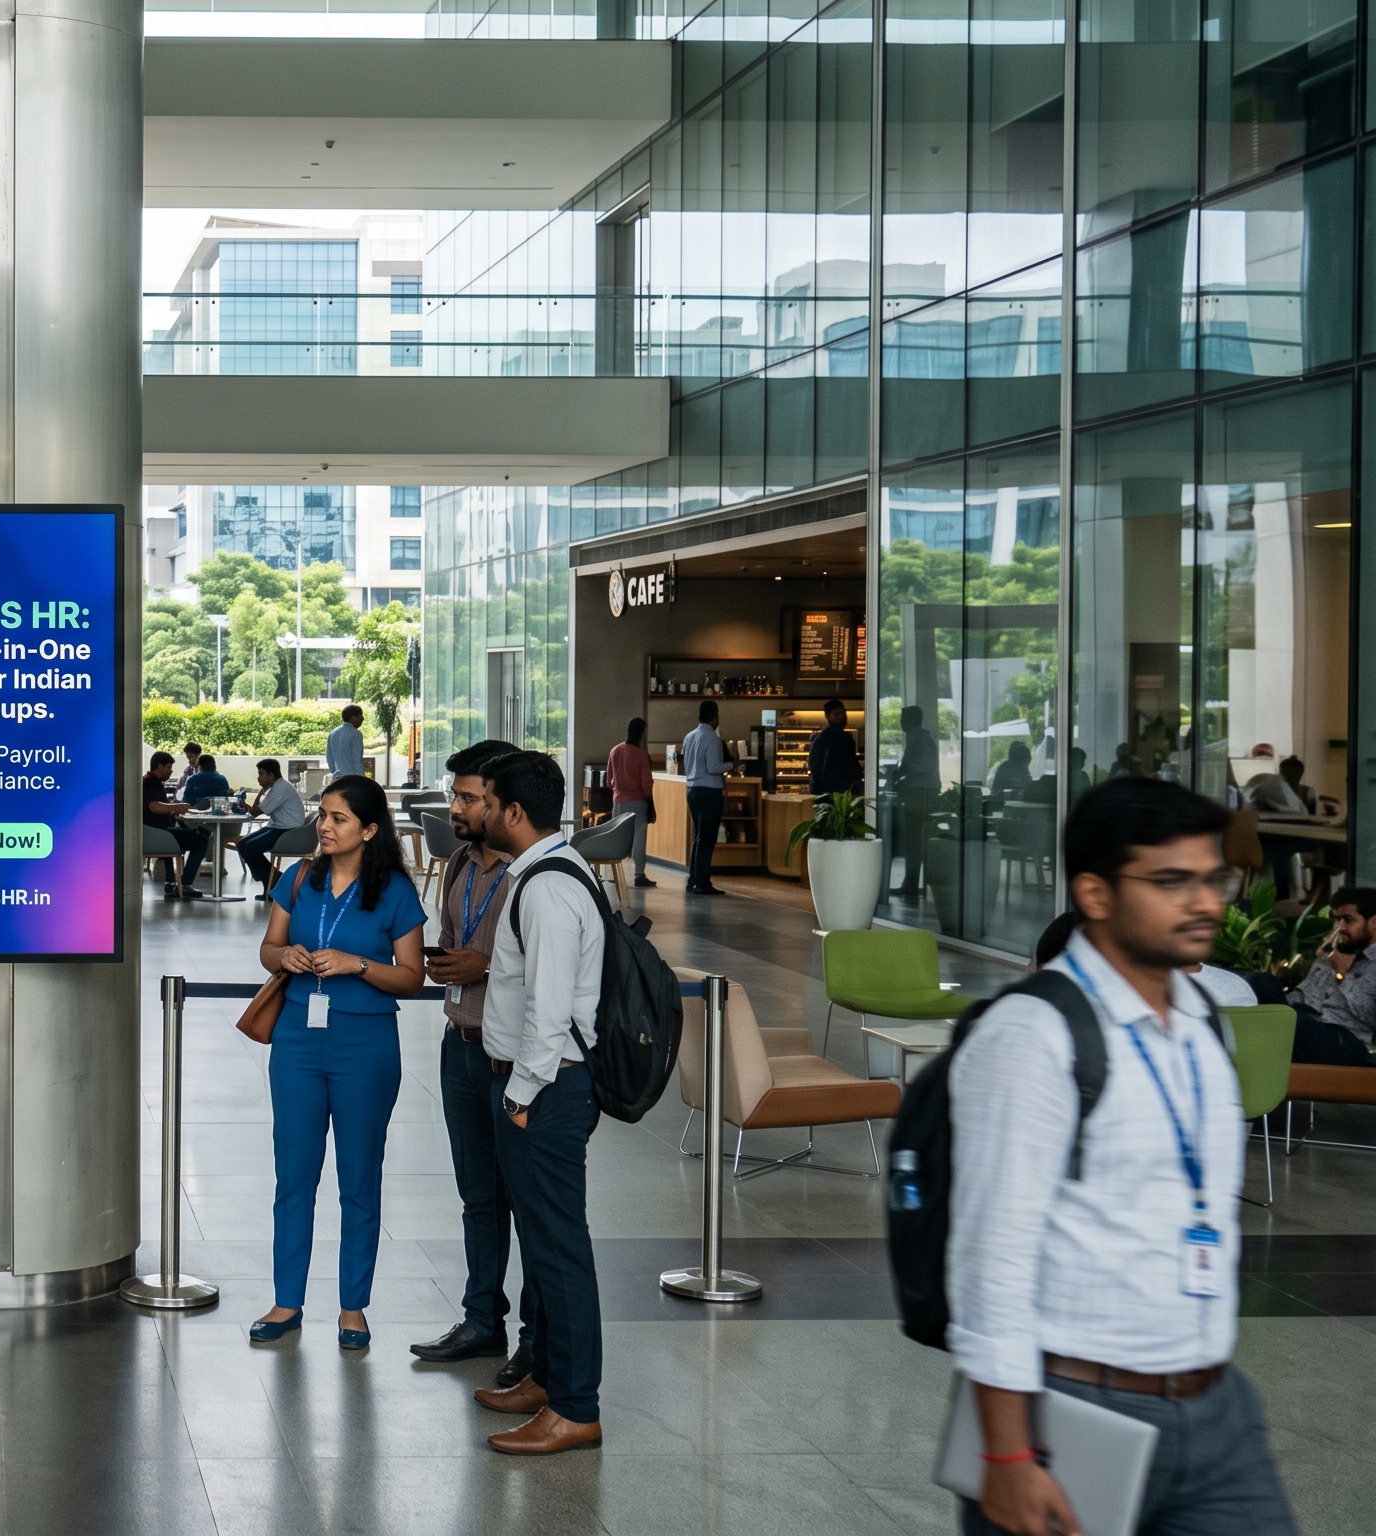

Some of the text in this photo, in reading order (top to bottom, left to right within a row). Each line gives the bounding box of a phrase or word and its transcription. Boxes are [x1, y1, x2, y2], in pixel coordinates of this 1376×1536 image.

[627, 573, 665, 607] CAFE
[32, 601, 90, 629] HR:
[13, 667, 91, 690] Indian
